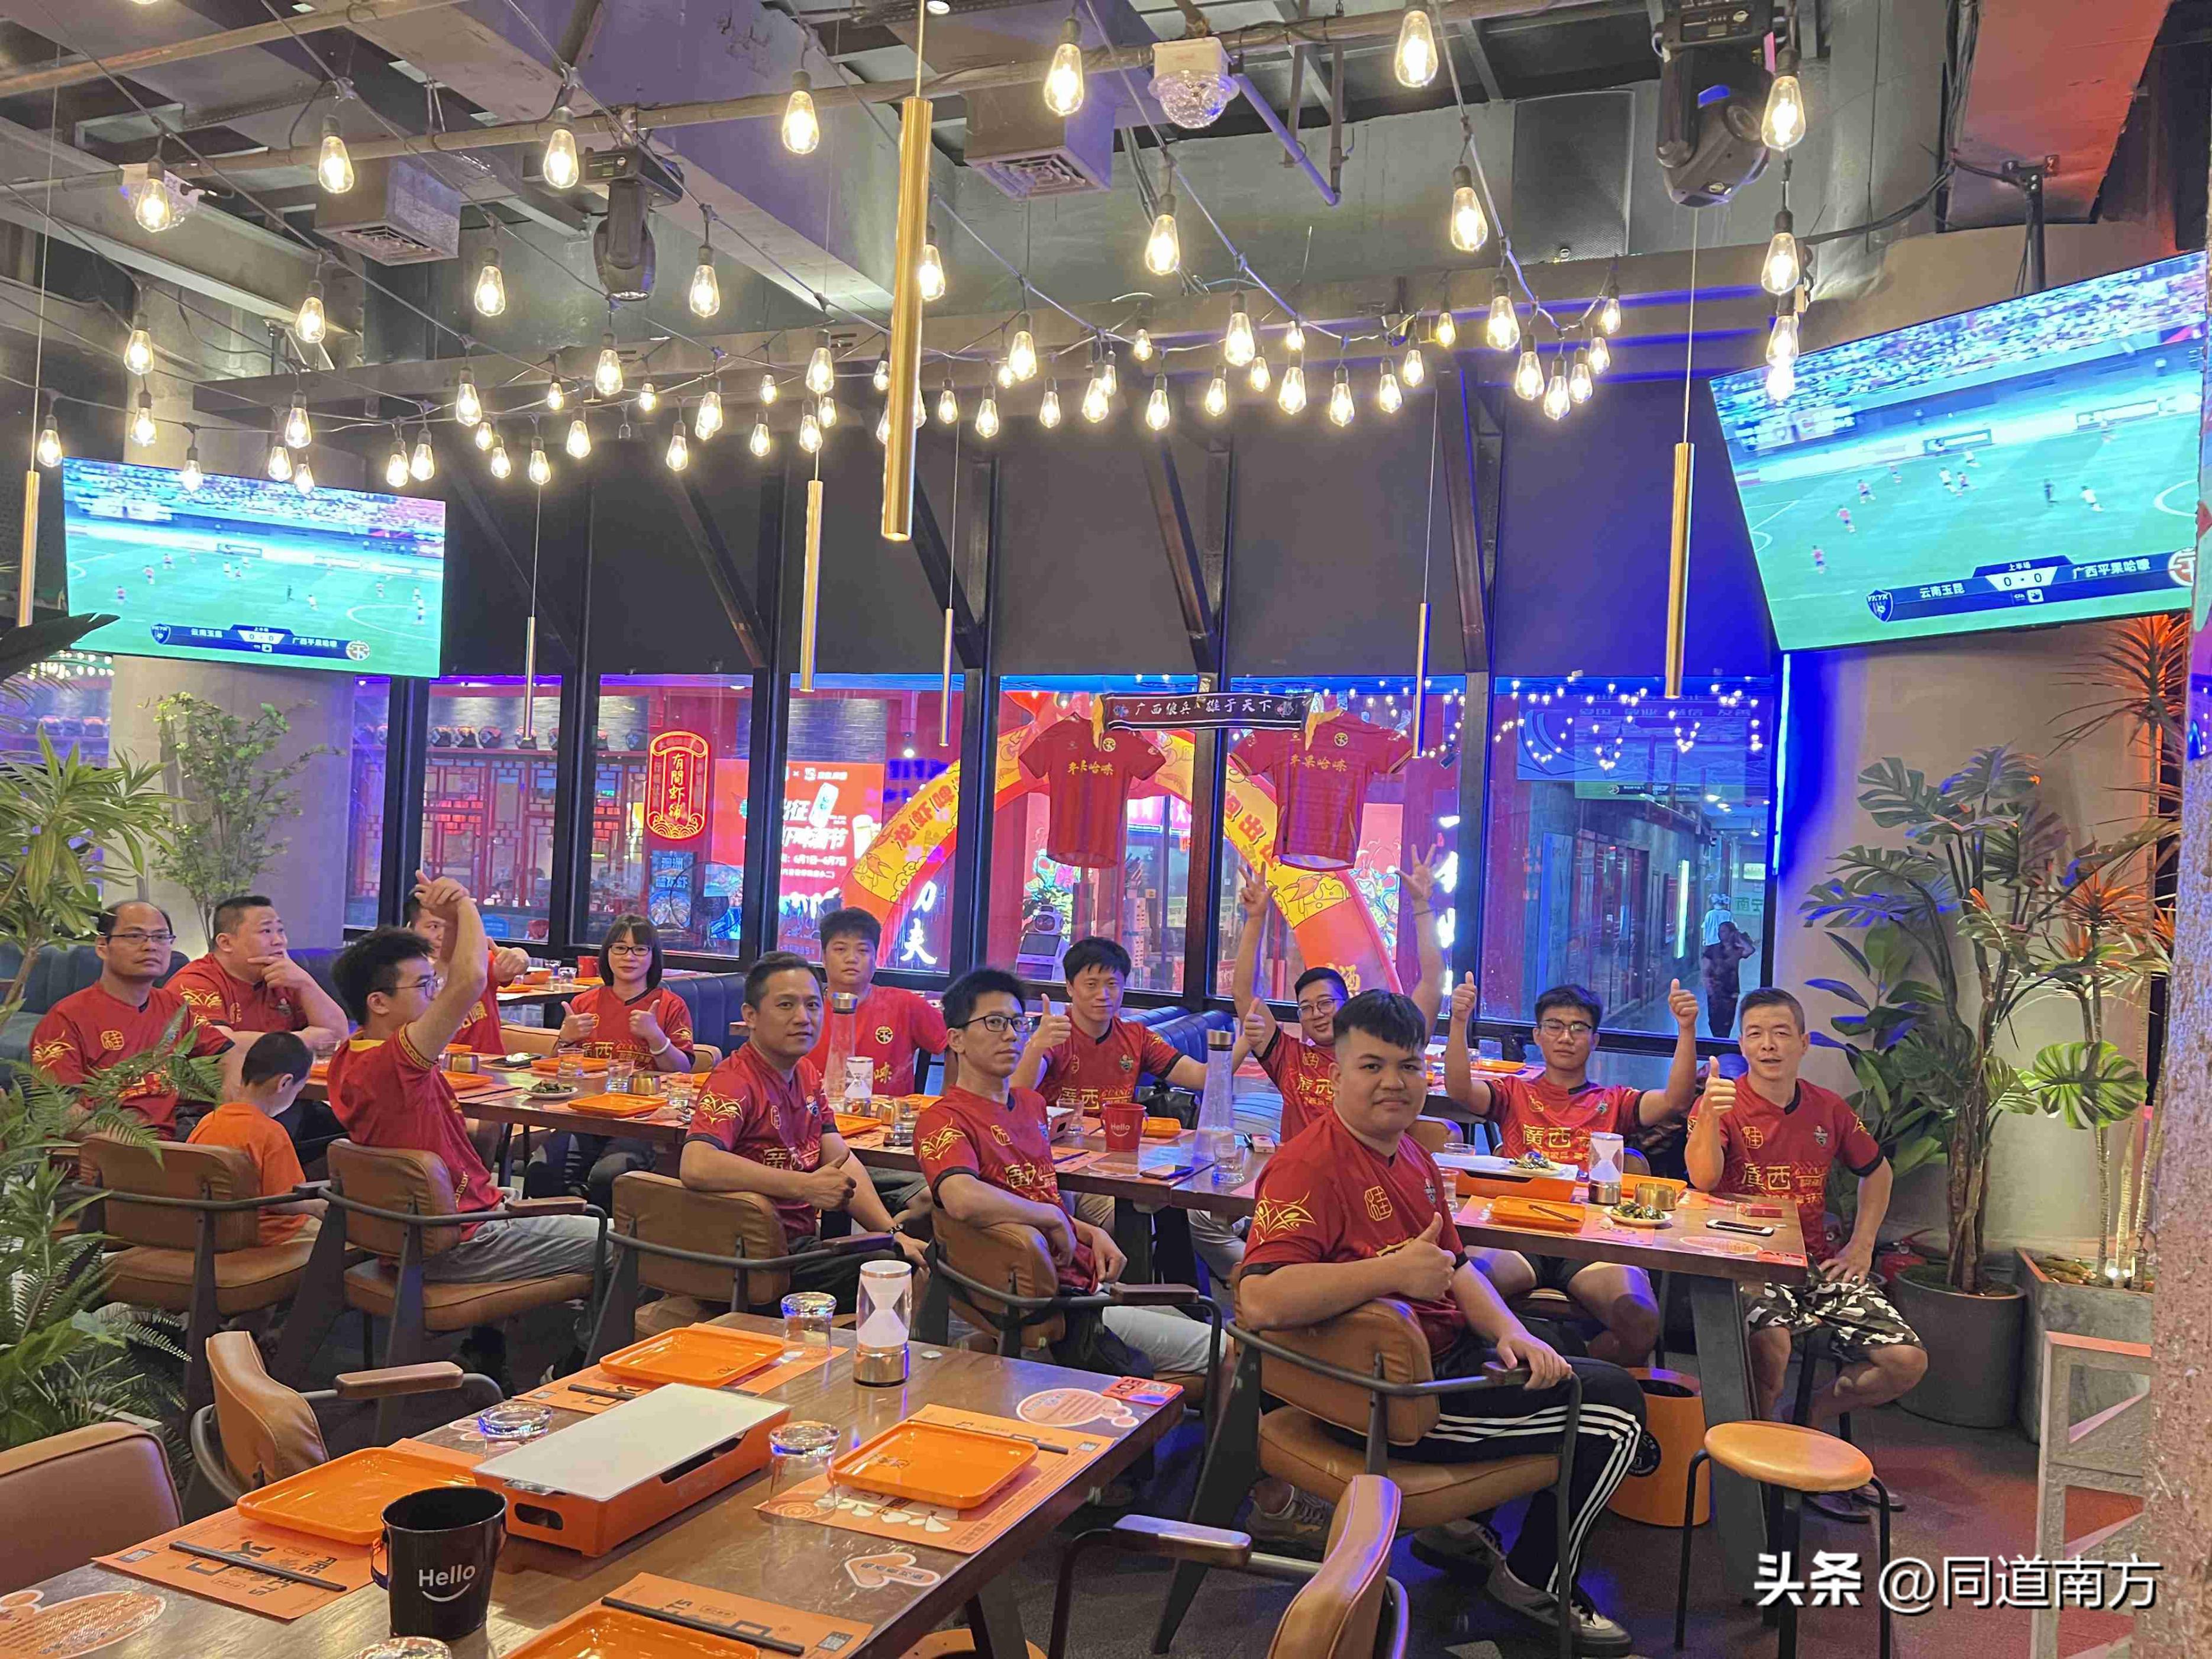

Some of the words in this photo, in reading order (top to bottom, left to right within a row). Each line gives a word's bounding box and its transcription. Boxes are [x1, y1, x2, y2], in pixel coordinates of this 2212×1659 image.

[2008, 562, 2031, 572] 上半场
[2004, 577, 2011, 587] 0
[2035, 573, 2043, 583] 0
[1919, 583, 1965, 599] 云南玉昆
[1523, 1124, 1571, 1148] 廣西
[1742, 1157, 1791, 1190] 廣西
[418, 1564, 475, 1587] Hello
